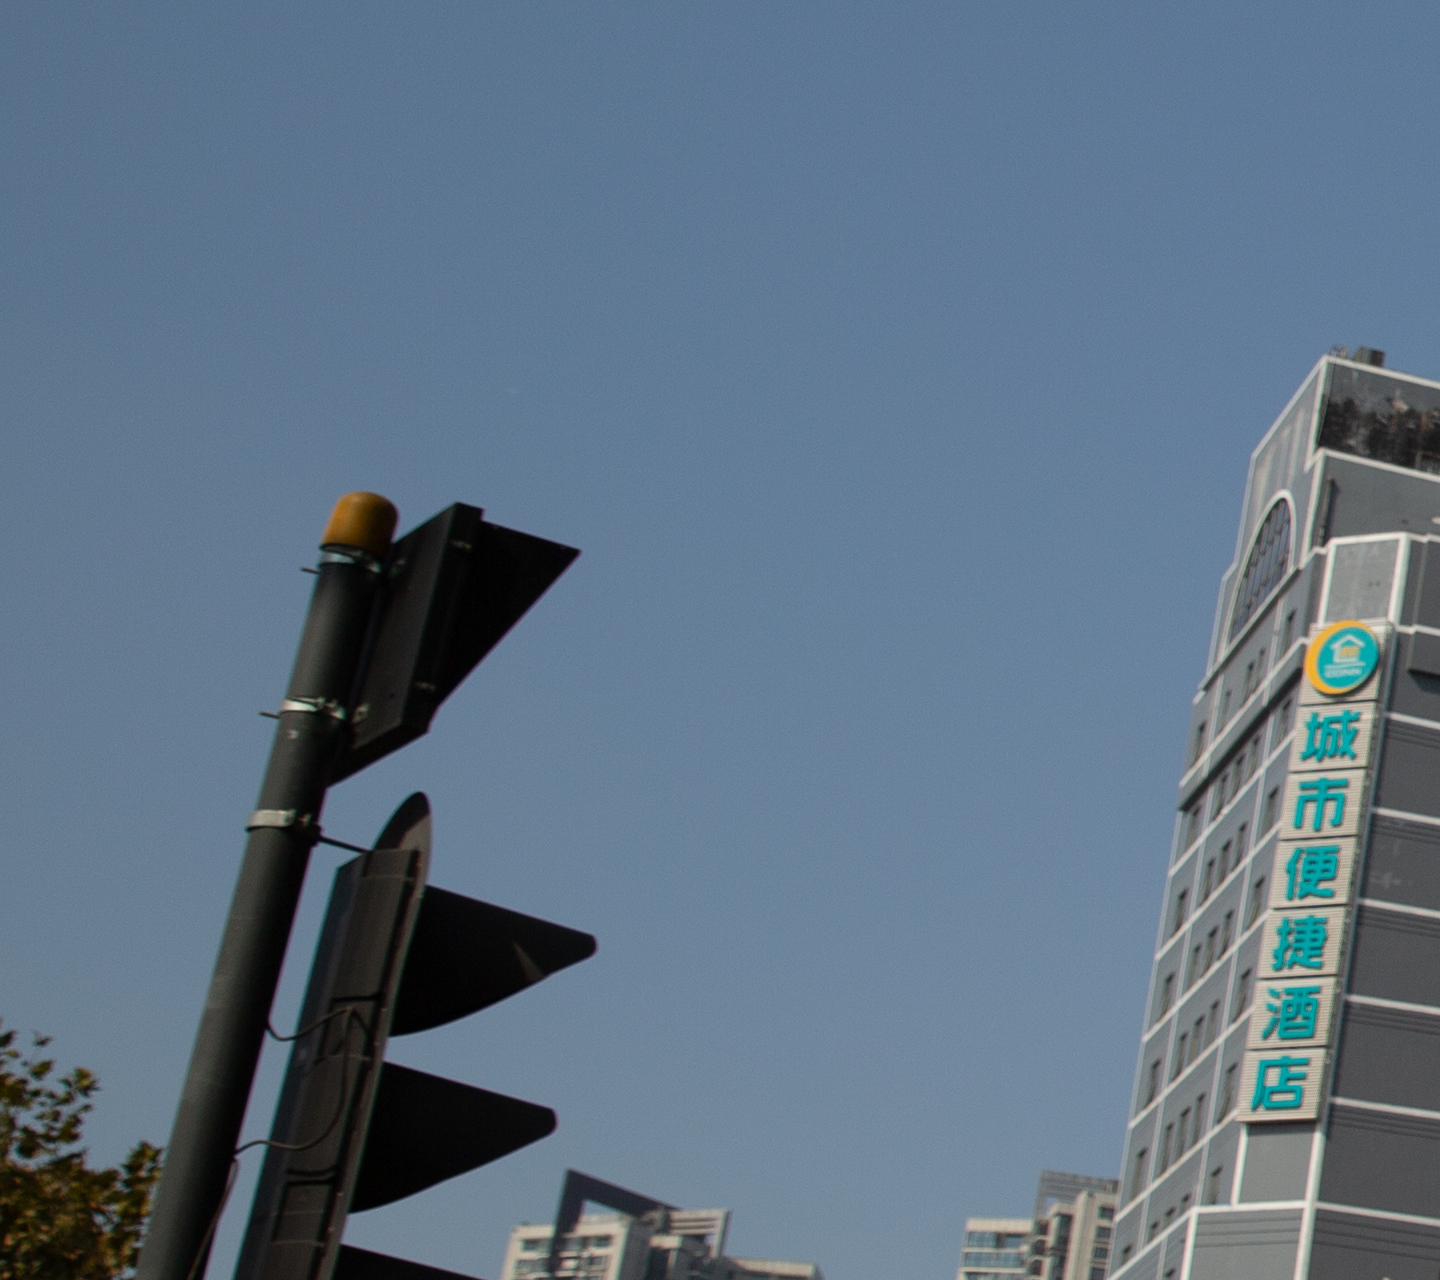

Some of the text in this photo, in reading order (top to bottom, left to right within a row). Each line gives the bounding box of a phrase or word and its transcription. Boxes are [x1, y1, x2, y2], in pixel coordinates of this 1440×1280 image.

[1252, 710, 1360, 1110] 城市便捷酒店
